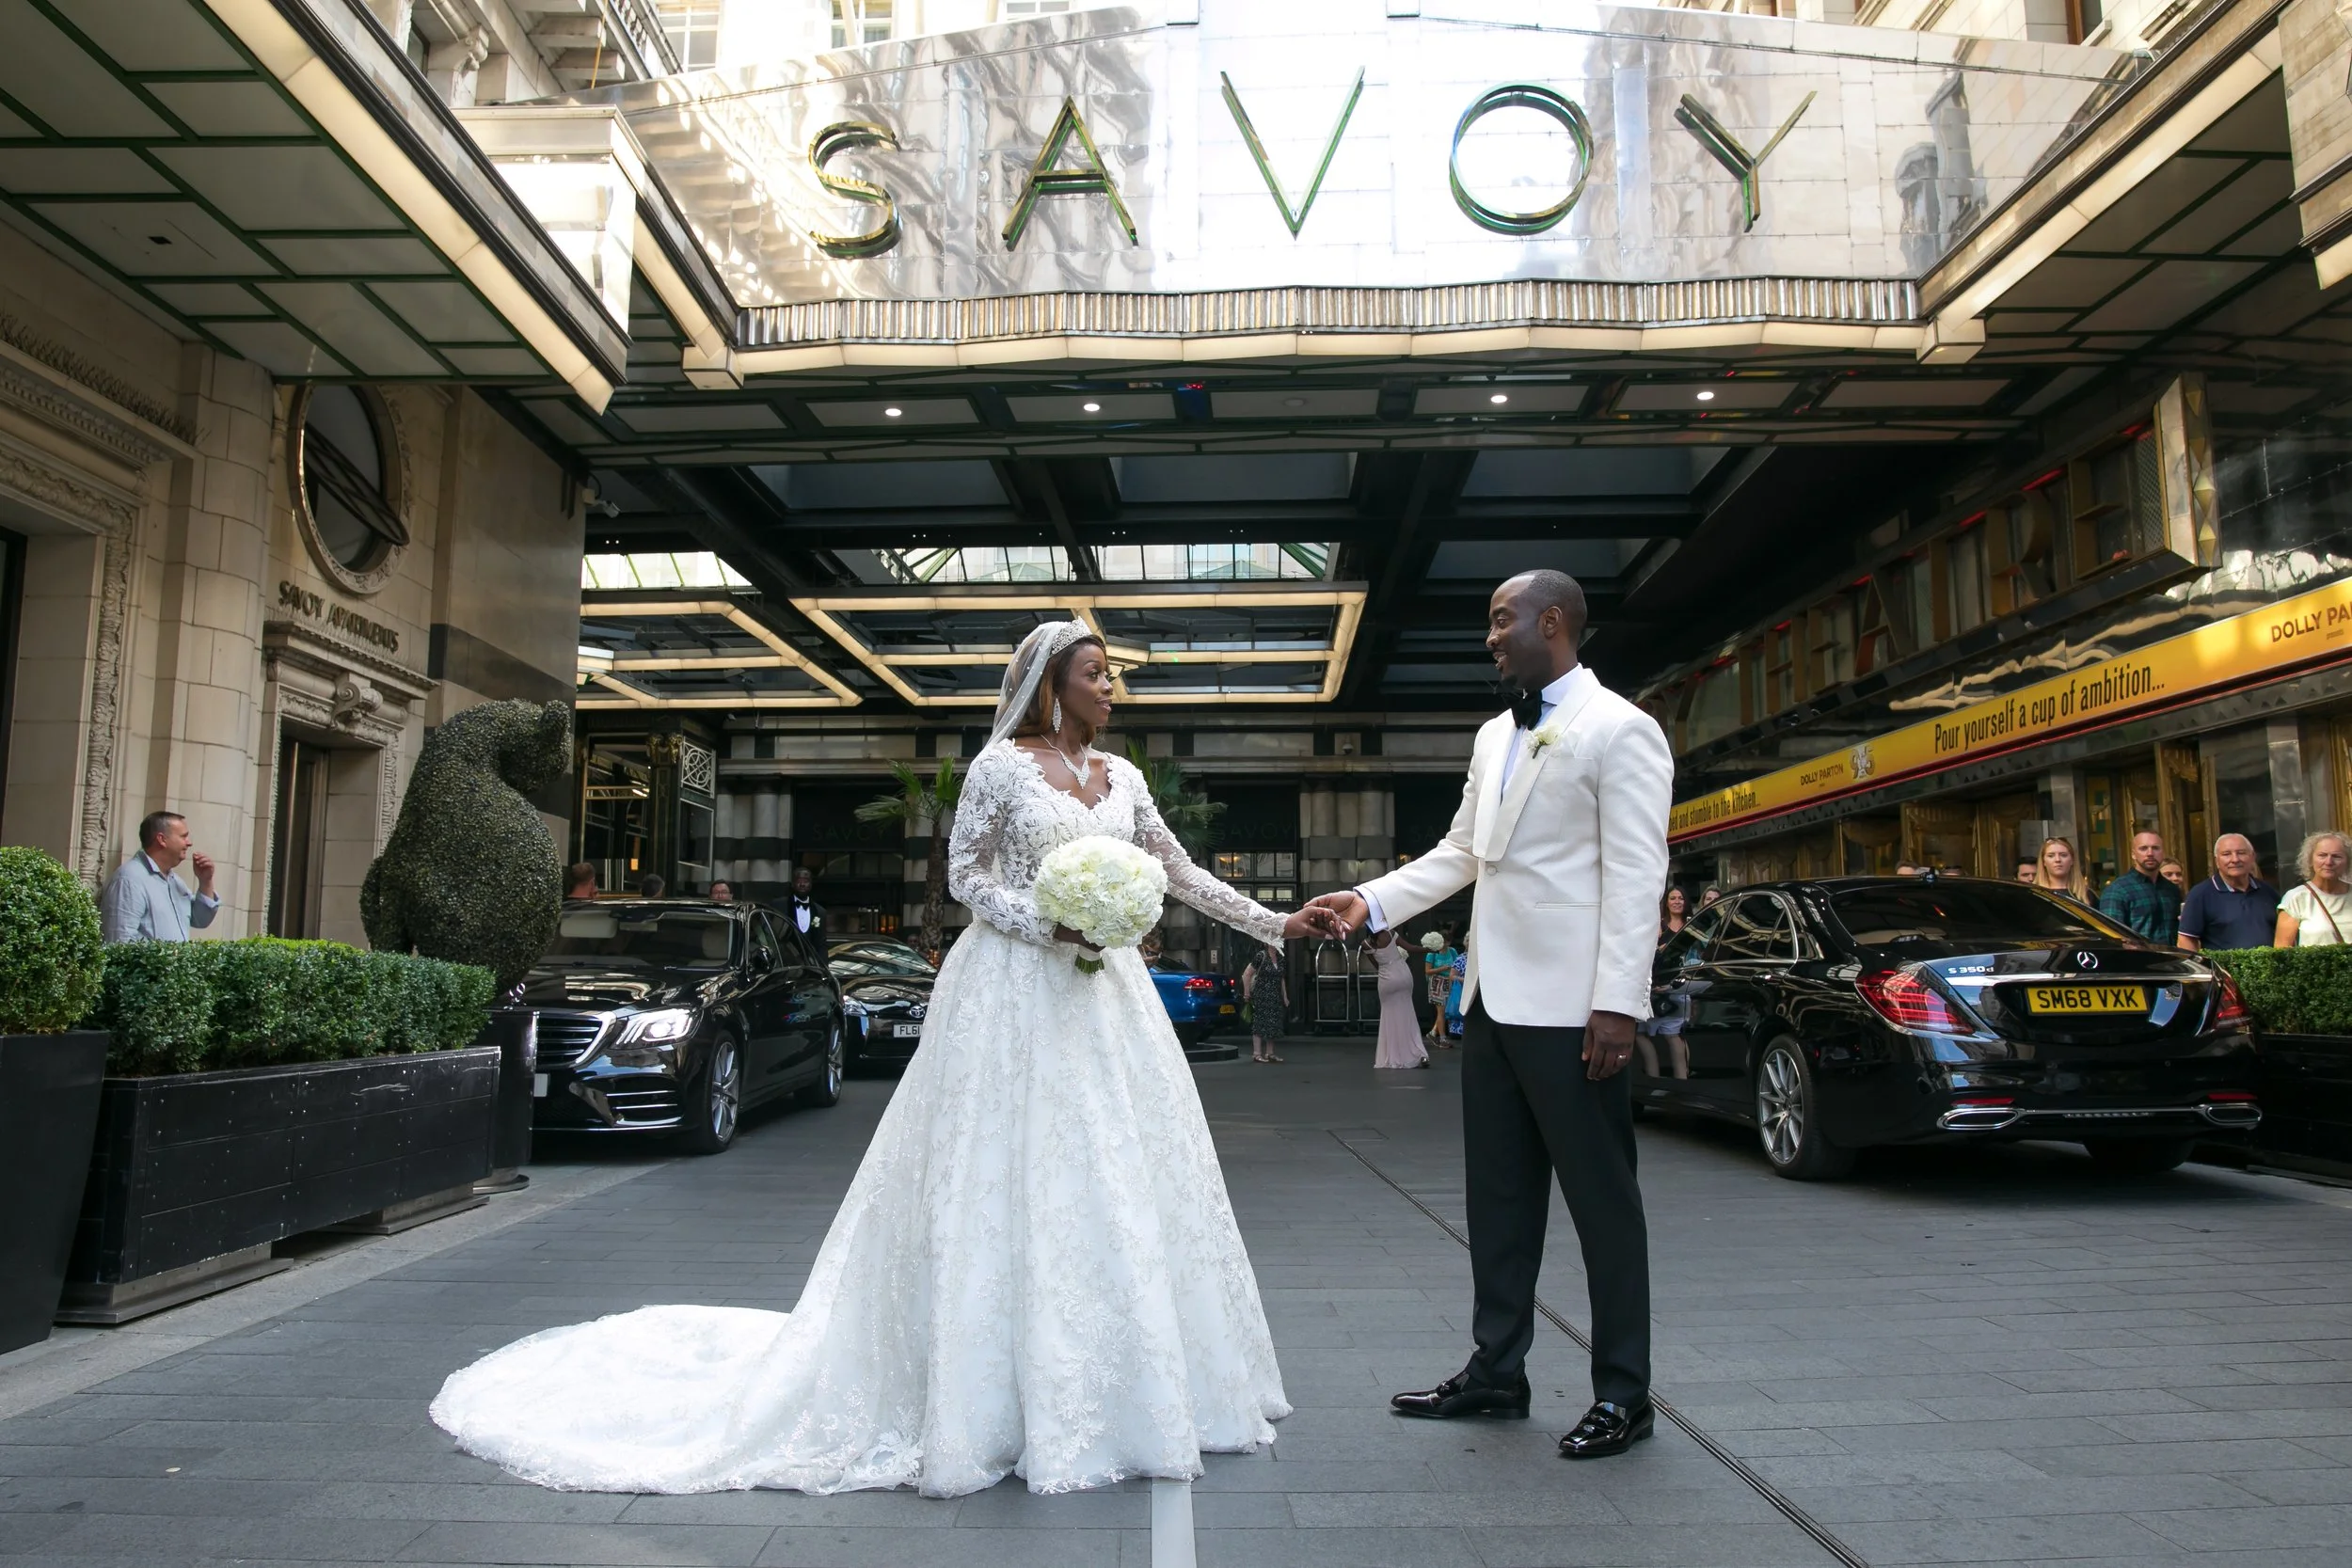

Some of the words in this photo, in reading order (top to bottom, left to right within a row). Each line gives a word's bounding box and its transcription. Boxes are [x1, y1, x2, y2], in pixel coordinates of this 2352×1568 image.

[807, 65, 1817, 261] SAVOY
[278, 580, 325, 619] SAVOY
[2271, 610, 2322, 642] DOLLY
[1935, 723, 1960, 753] Pour
[1964, 698, 2014, 750] yourself
[2019, 704, 2026, 728] a
[2032, 695, 2056, 727] cup
[2061, 679, 2075, 717] of
[2081, 663, 2165, 711] ambition...
[1801, 770, 1818, 786] DOLLY
[1819, 763, 1844, 781] PARTON
[1721, 794, 1730, 816] the
[2036, 990, 2092, 1008] SM68
[2096, 989, 2138, 1007] VXK
